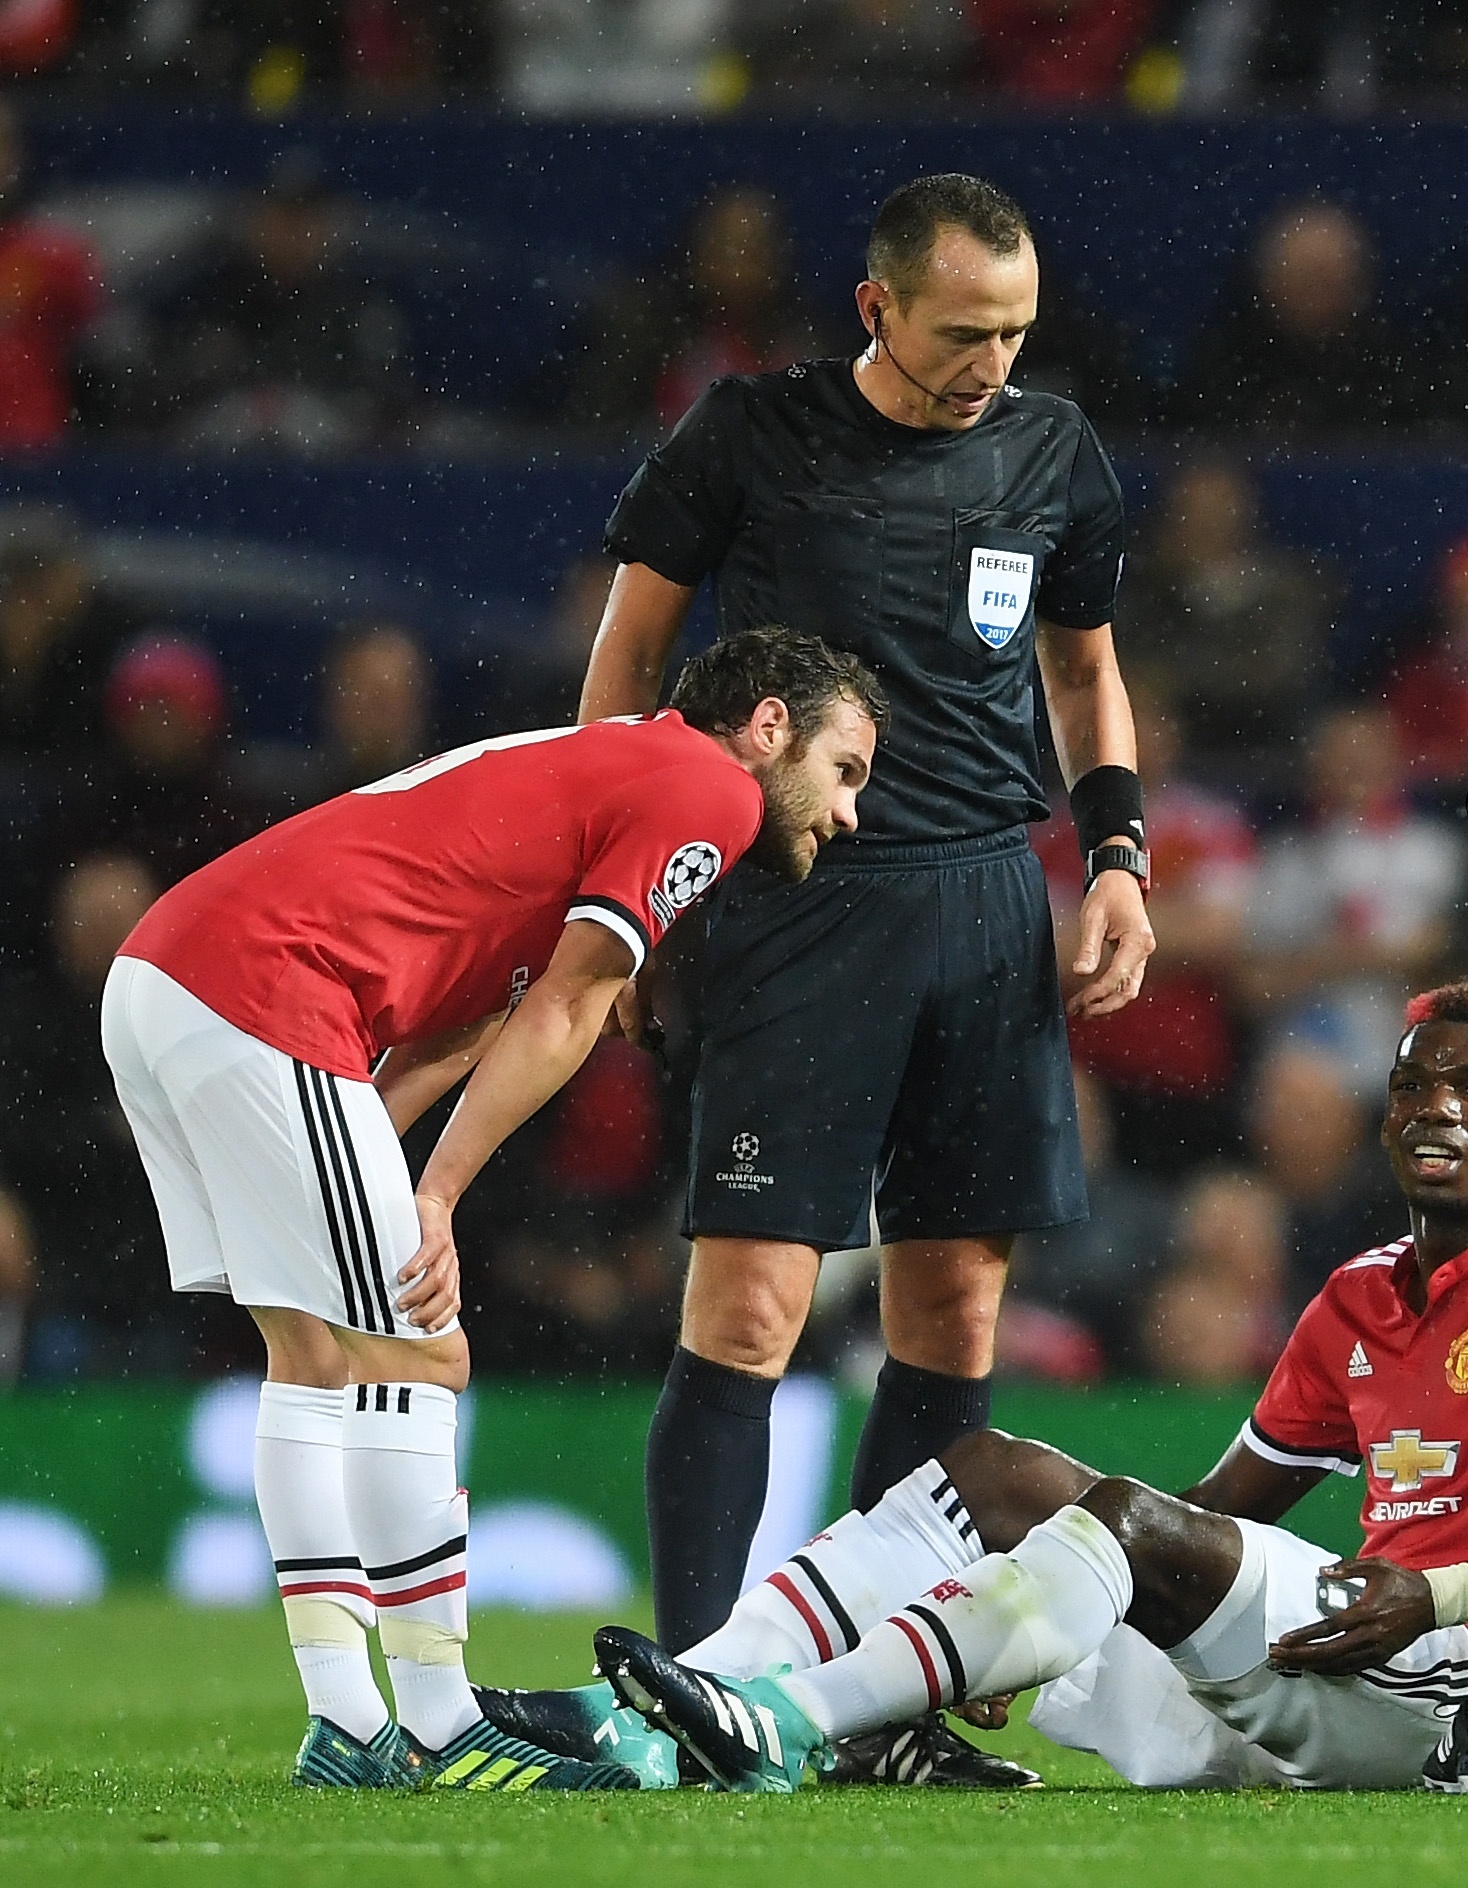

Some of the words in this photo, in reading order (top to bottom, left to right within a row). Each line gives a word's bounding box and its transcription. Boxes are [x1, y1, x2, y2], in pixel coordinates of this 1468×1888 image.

[977, 556, 1028, 574] REFEREE
[983, 590, 1017, 609] FIFA
[986, 628, 1009, 640] 2017
[716, 1172, 774, 1185] CHAMPIONS
[728, 1182, 758, 1191] LEAGUE
